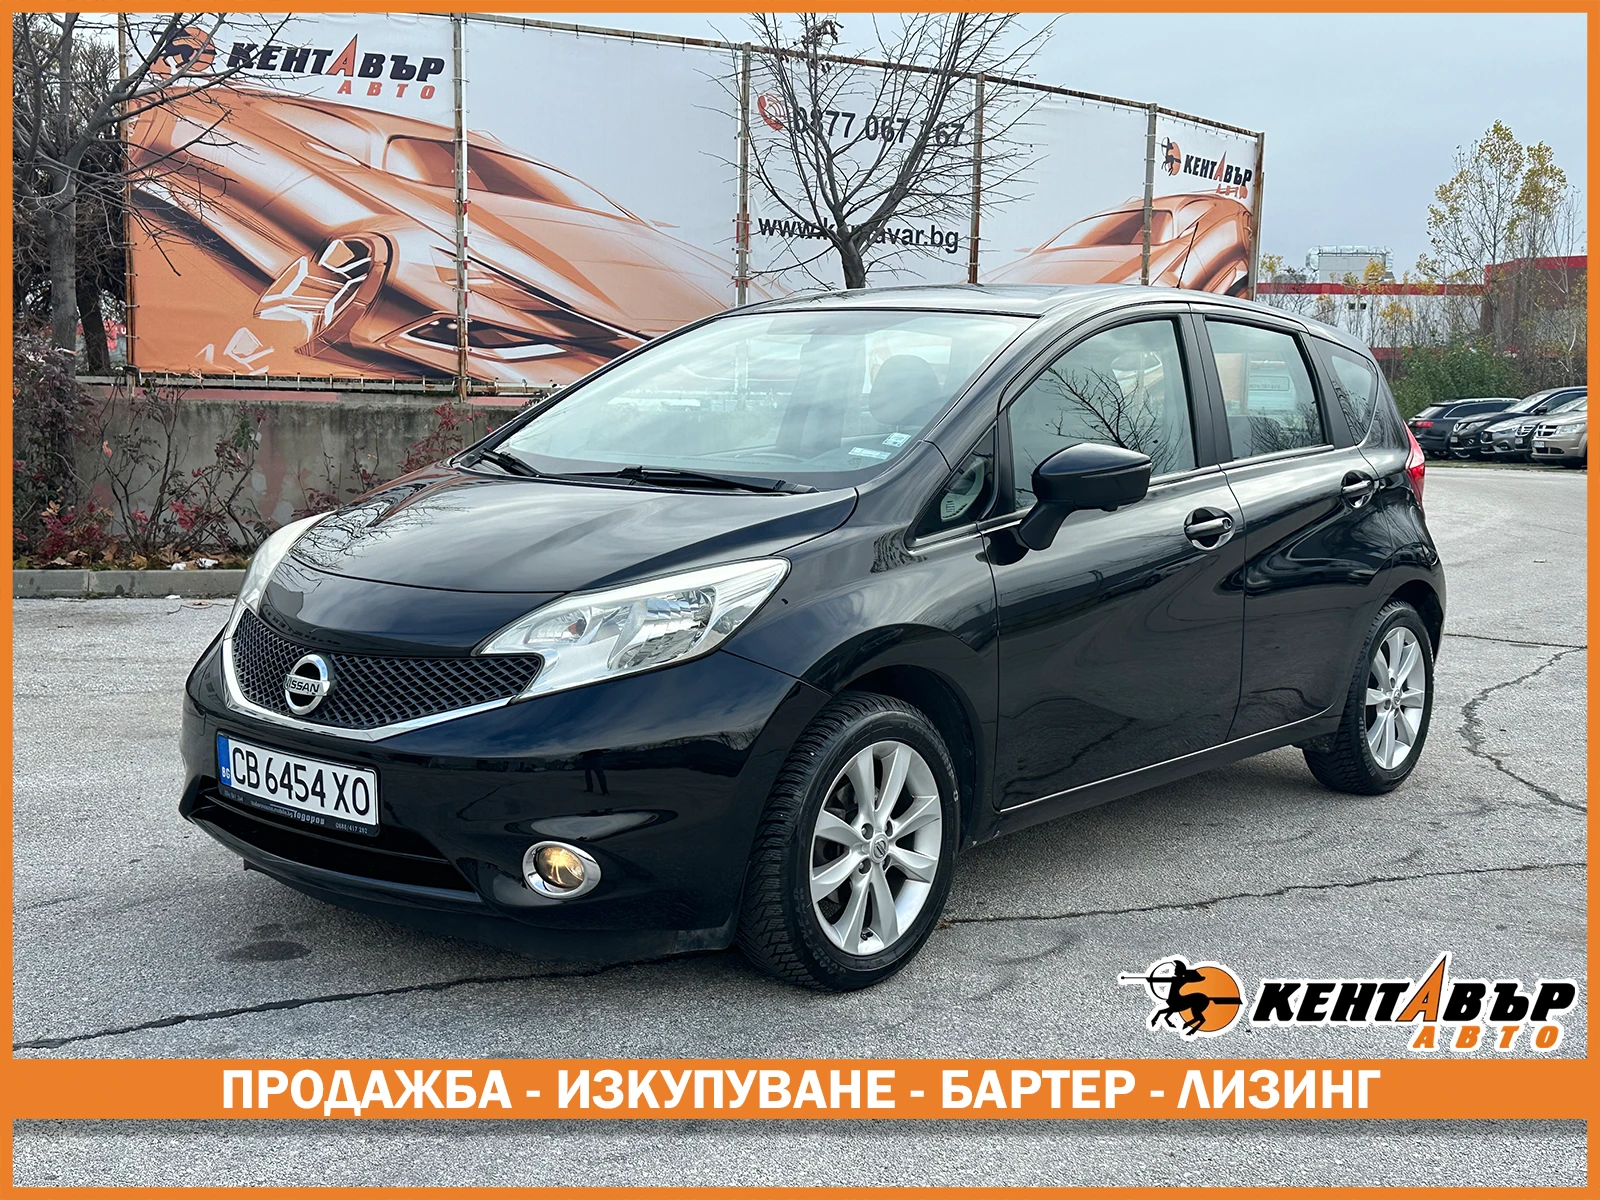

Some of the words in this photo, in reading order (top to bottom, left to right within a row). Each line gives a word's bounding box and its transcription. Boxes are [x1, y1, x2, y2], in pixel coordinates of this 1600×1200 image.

[227, 34, 445, 82] КЕНТАВЪР
[337, 81, 436, 99] АВТО
[865, 114, 911, 143] 067
[1183, 150, 1253, 187] КЕНТАВЪР
[758, 217, 959, 254] www.kavar.bg
[221, 765, 231, 779] BG
[265, 757, 326, 808] 6454
